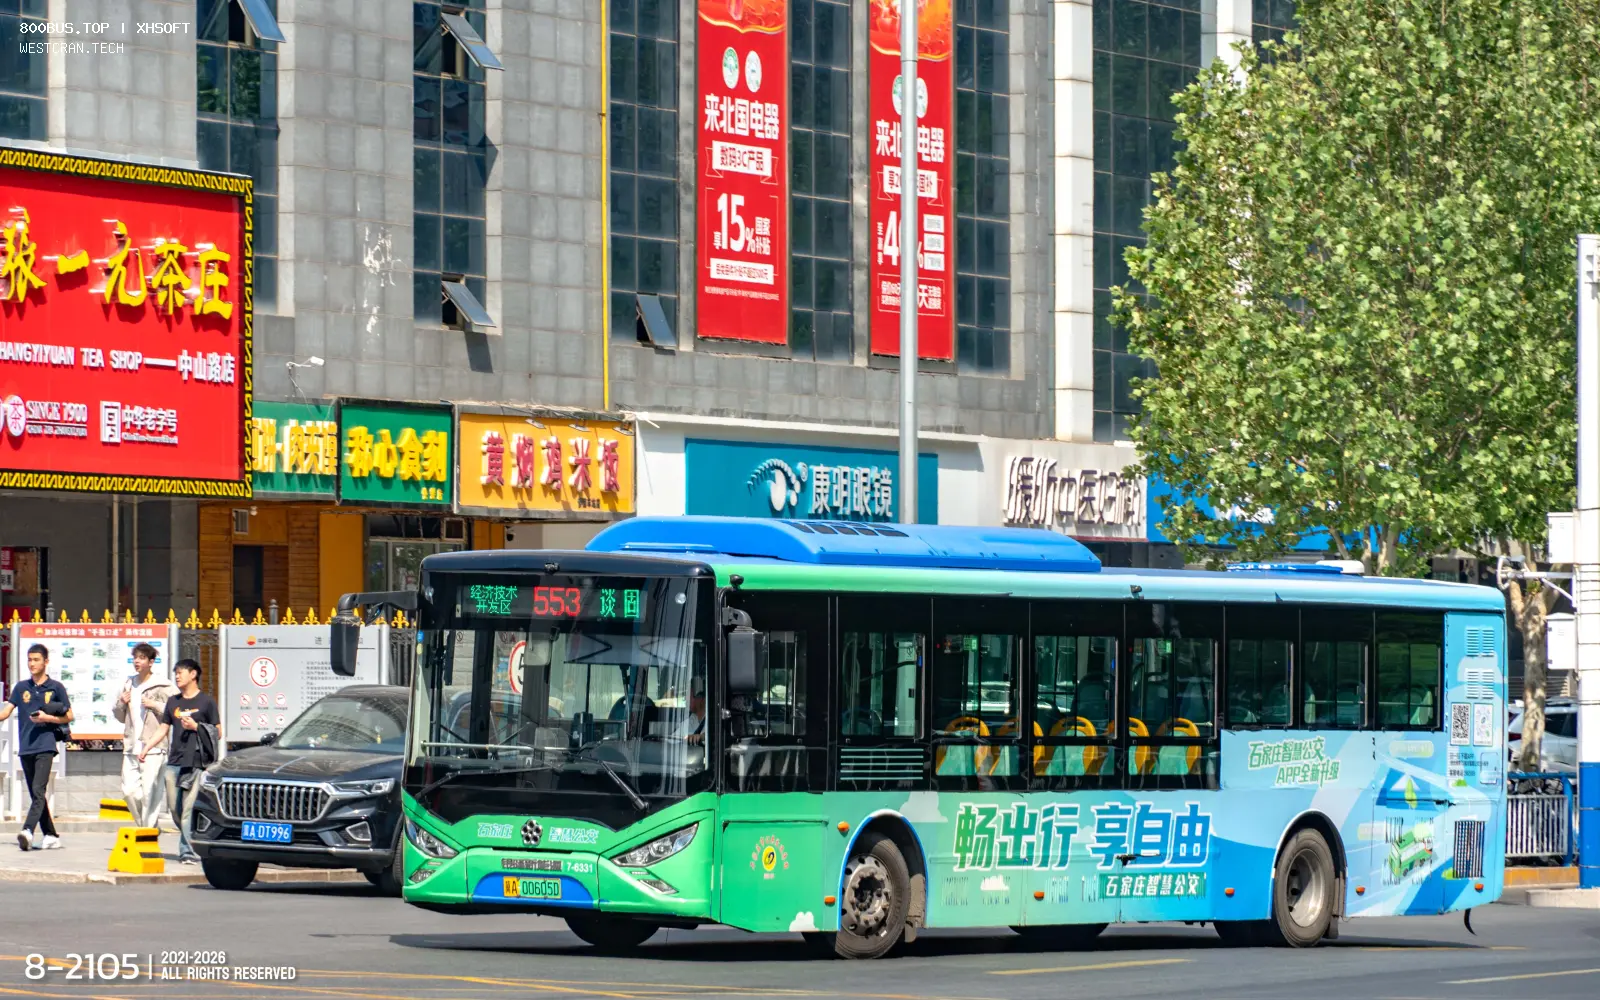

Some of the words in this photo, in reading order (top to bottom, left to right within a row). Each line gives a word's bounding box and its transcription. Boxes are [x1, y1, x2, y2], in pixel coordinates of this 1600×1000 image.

[704, 93, 779, 140] 来北国电器
[876, 119, 945, 163] 来北电器
[720, 145, 764, 171] 数码3C产品
[0, 207, 233, 319] 张一元茶庄
[80, 348, 105, 367] TEA
[110, 350, 142, 370] SHOP
[177, 349, 236, 383] 中山路店
[26, 401, 60, 420] SINCE
[121, 404, 178, 432] 中华老字号
[480, 430, 621, 492] 黄焖鸡米饭
[809, 463, 893, 517] 康明眼镜
[470, 584, 518, 599] 经济技术
[533, 586, 581, 617] 553
[599, 588, 640, 619] 谈固
[476, 599, 512, 615] 开发区
[259, 665, 268, 679] 5
[1248, 736, 1326, 769] 石家庄智慧公交
[1275, 759, 1341, 788] APP全新升级
[477, 822, 514, 839] 石家庄
[548, 826, 600, 844] 智慧公交
[953, 801, 1080, 872] 畅出行
[1086, 801, 1213, 869] 享自由
[566, 861, 594, 873] 7-6331
[1105, 874, 1201, 898] 石家庄智慧公交
